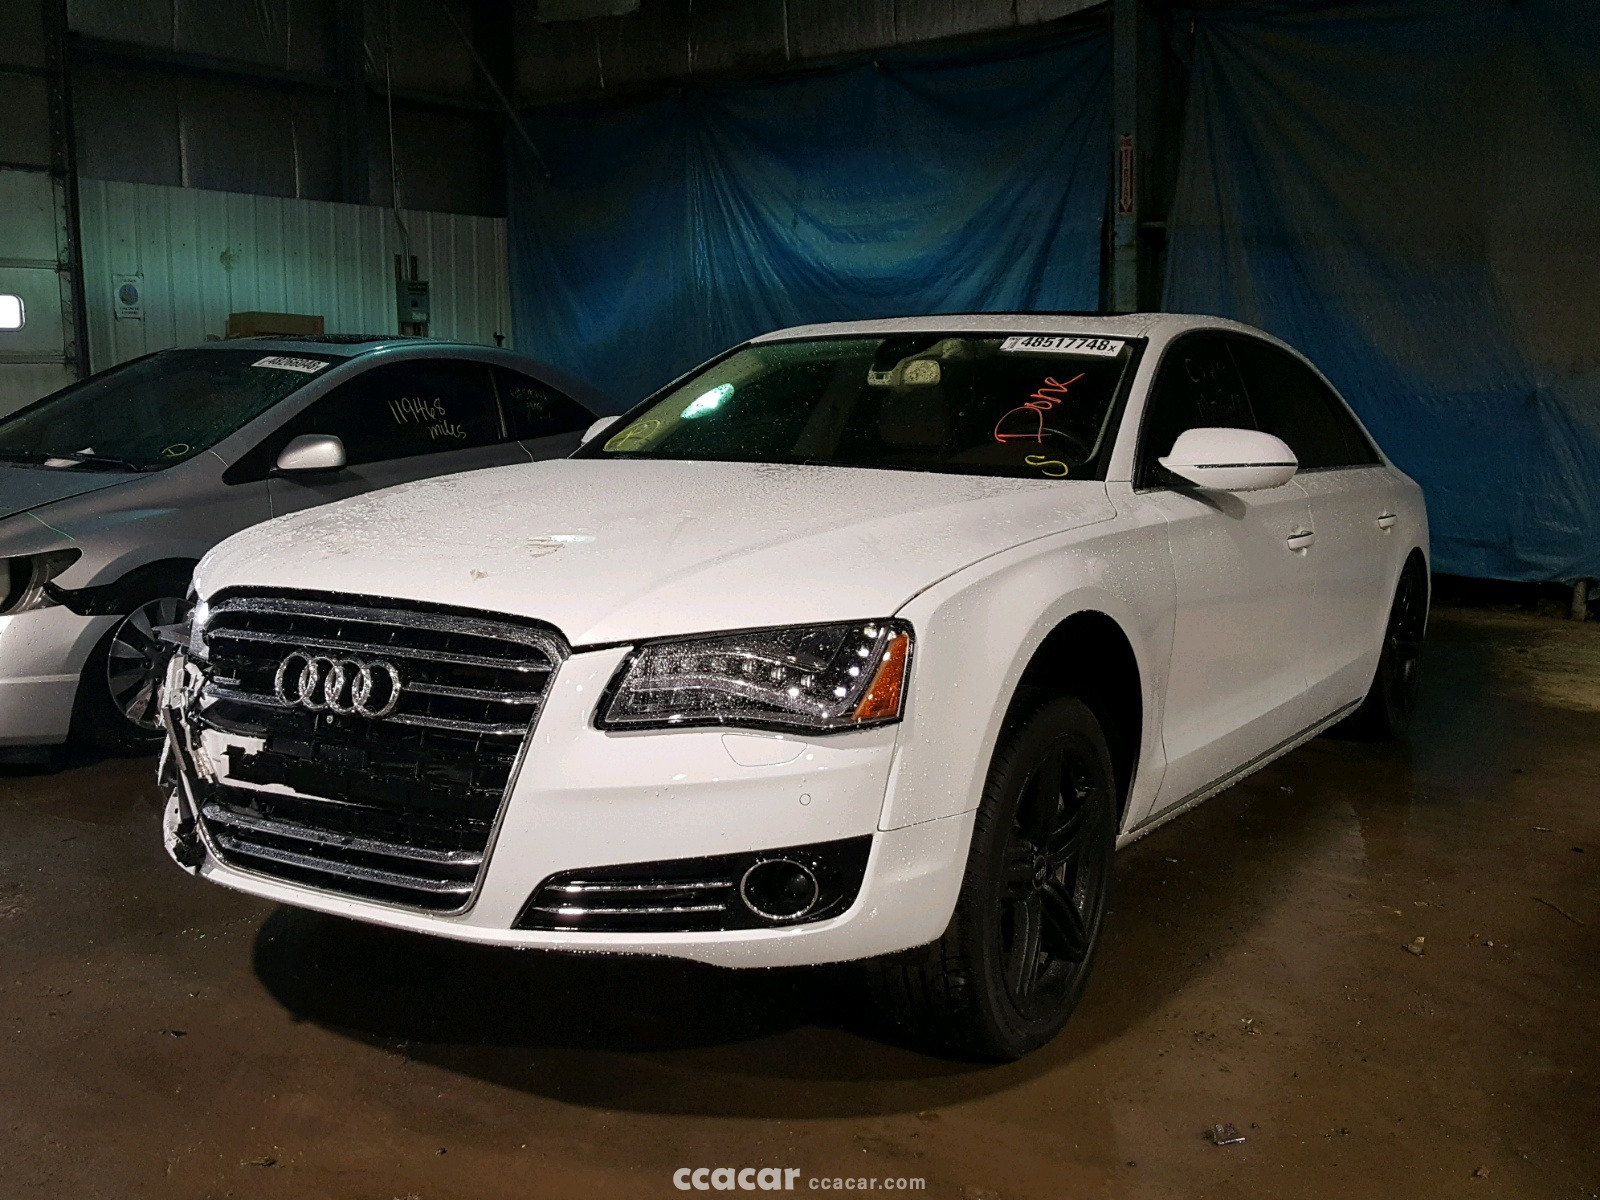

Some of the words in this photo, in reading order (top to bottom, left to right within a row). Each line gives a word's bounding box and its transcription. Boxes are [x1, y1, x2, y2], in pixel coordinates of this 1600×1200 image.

[388, 397, 446, 424] 119468
[994, 372, 1085, 444] Done
[428, 420, 467, 440] miles
